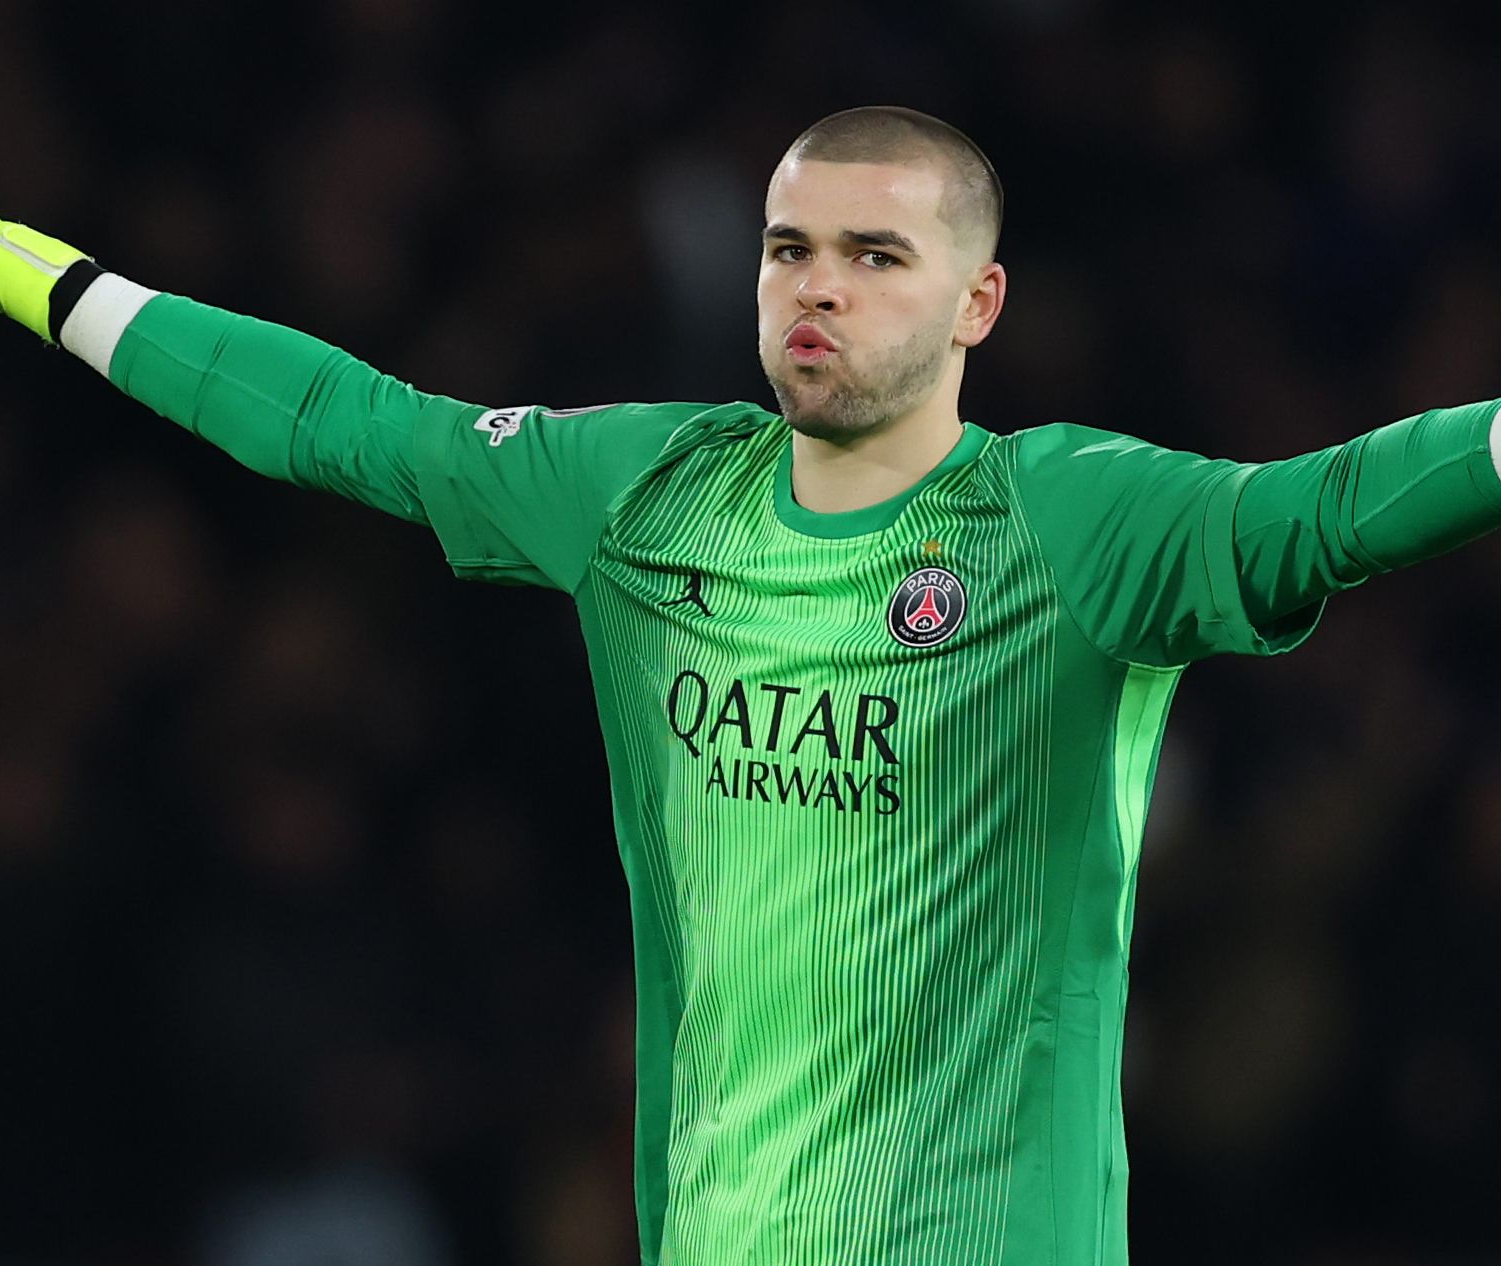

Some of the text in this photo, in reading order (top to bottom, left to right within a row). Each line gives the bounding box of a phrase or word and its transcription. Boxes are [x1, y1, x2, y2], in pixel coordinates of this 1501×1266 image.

[906, 572, 954, 593] PARIS
[668, 670, 900, 765] QATAR
[706, 756, 900, 815] AIRWAYS
